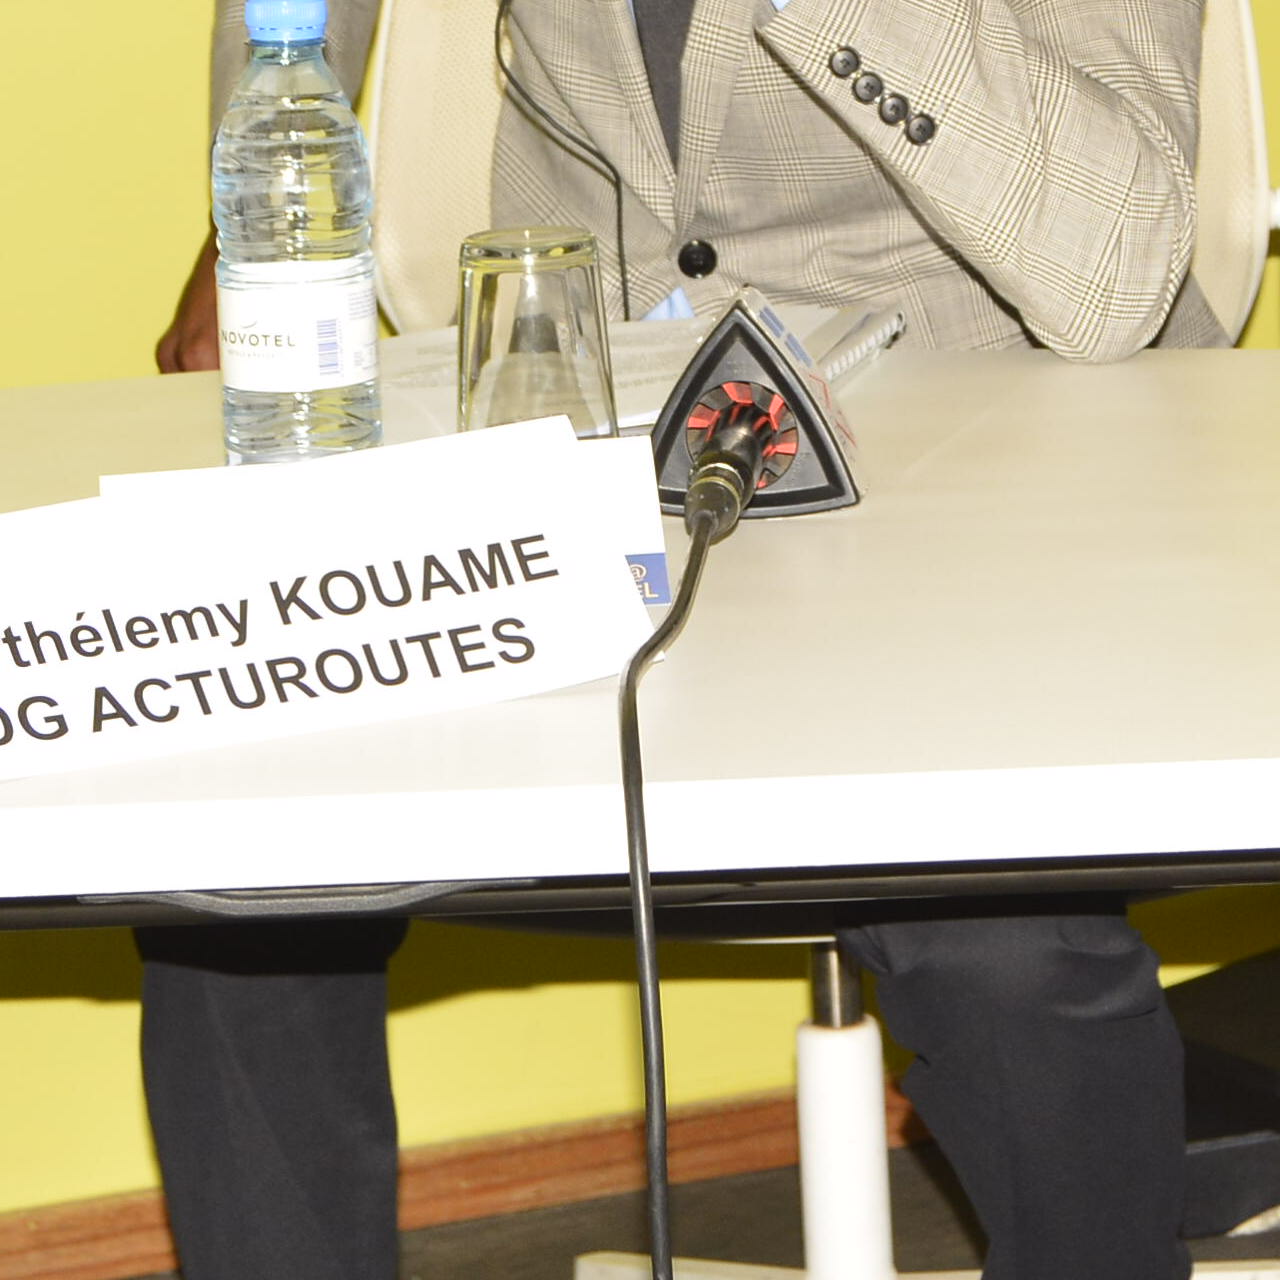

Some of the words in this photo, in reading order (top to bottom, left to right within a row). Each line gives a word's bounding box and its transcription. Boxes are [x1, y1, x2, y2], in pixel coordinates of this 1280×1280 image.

[220, 327, 297, 348] NOVOTEL
[269, 534, 559, 626] KOUAME
[92, 617, 535, 733] ACTUROUTES
